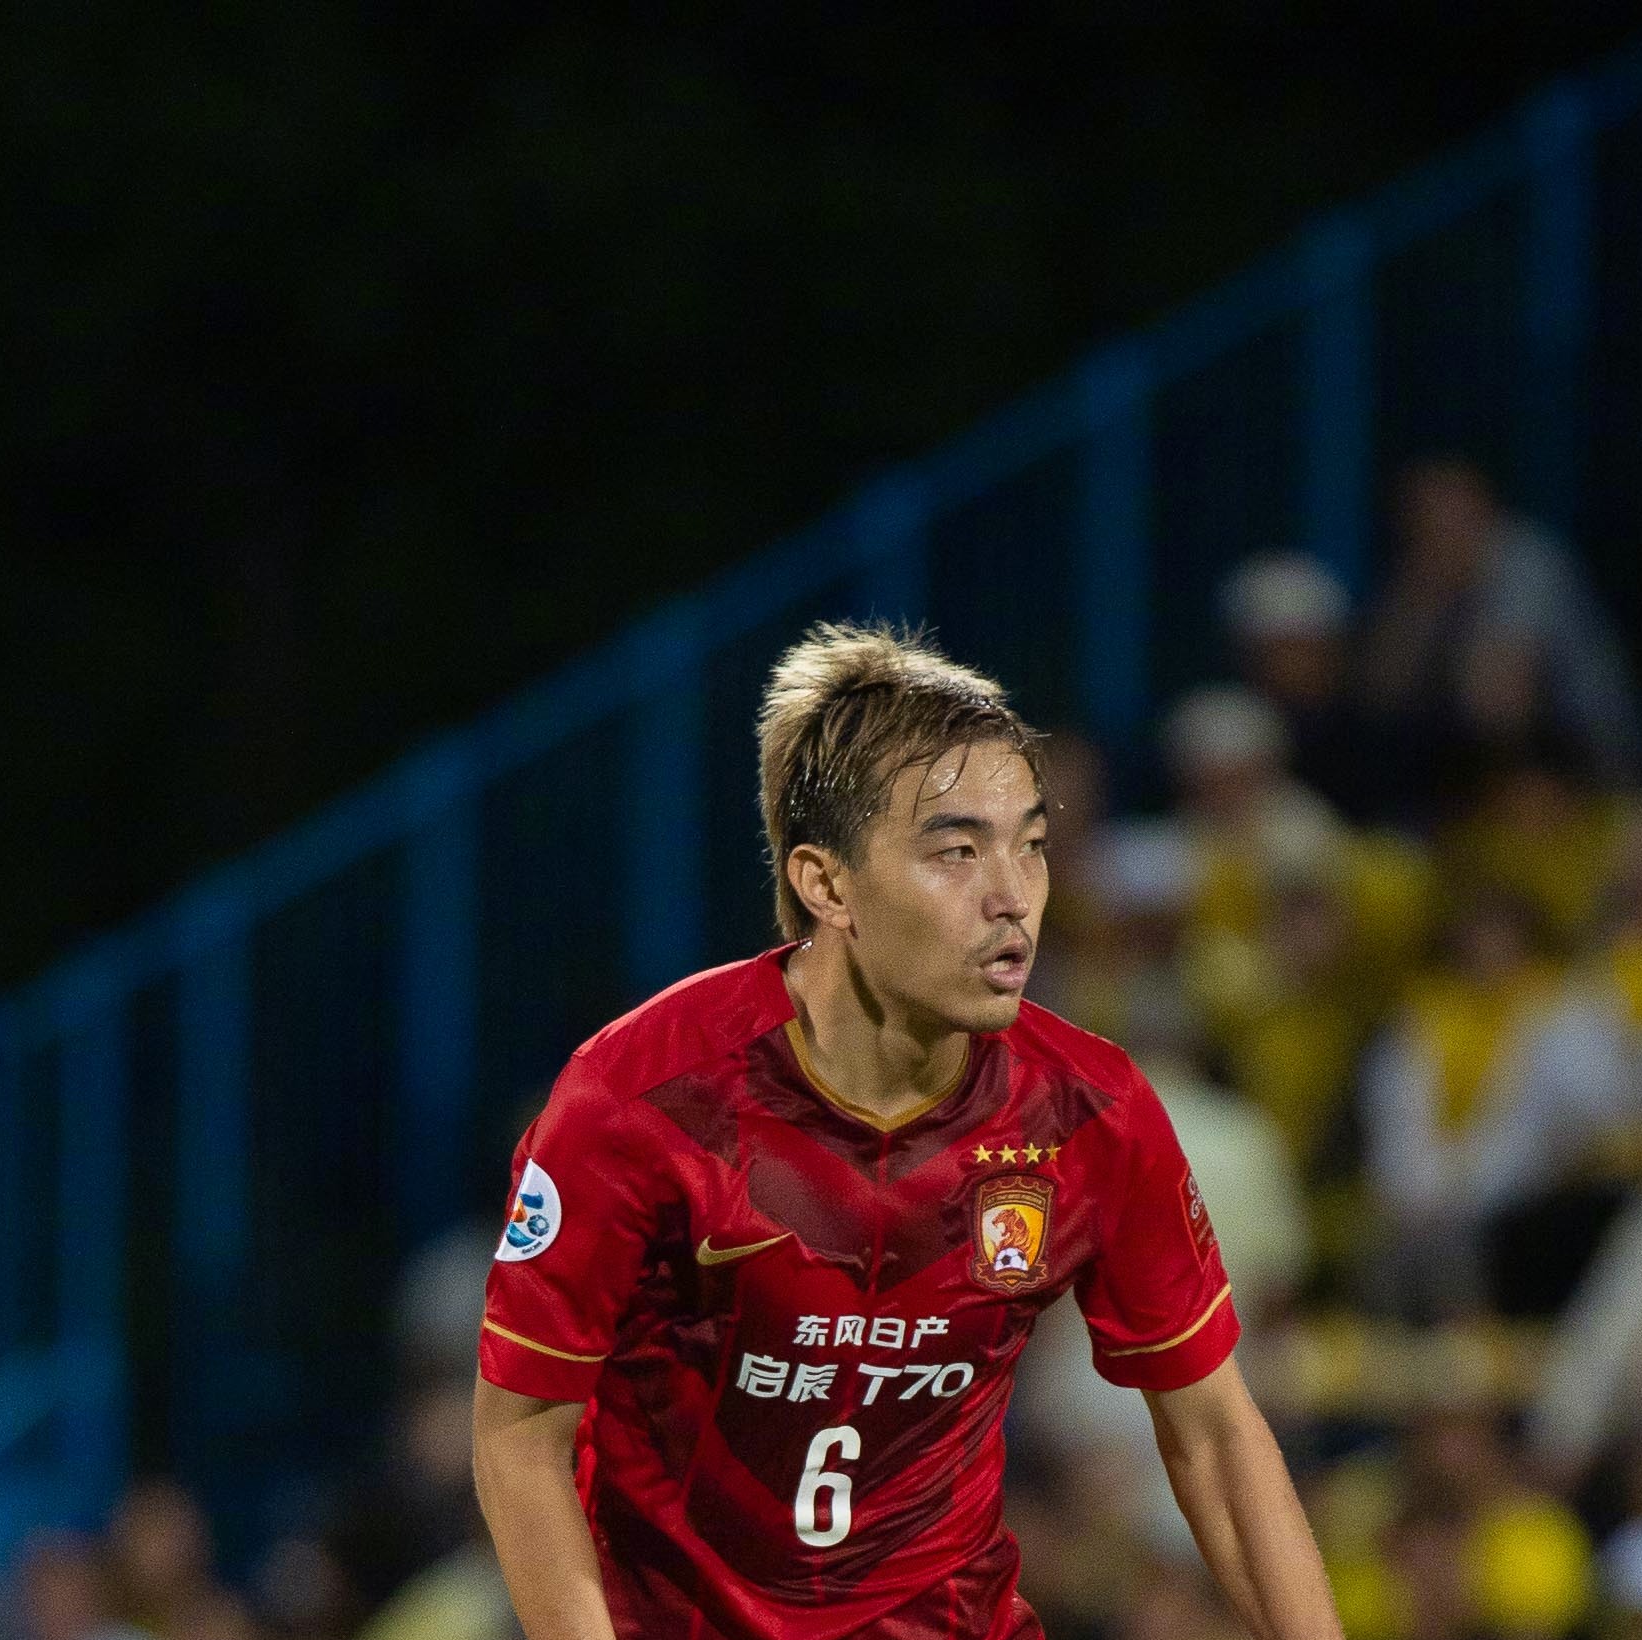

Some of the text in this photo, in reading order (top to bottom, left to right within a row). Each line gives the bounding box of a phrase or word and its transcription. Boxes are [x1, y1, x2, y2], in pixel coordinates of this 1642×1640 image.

[791, 1315, 950, 1349] 东风日产
[736, 1352, 974, 1406] 启辰 T70
[795, 1425, 861, 1547] 6
